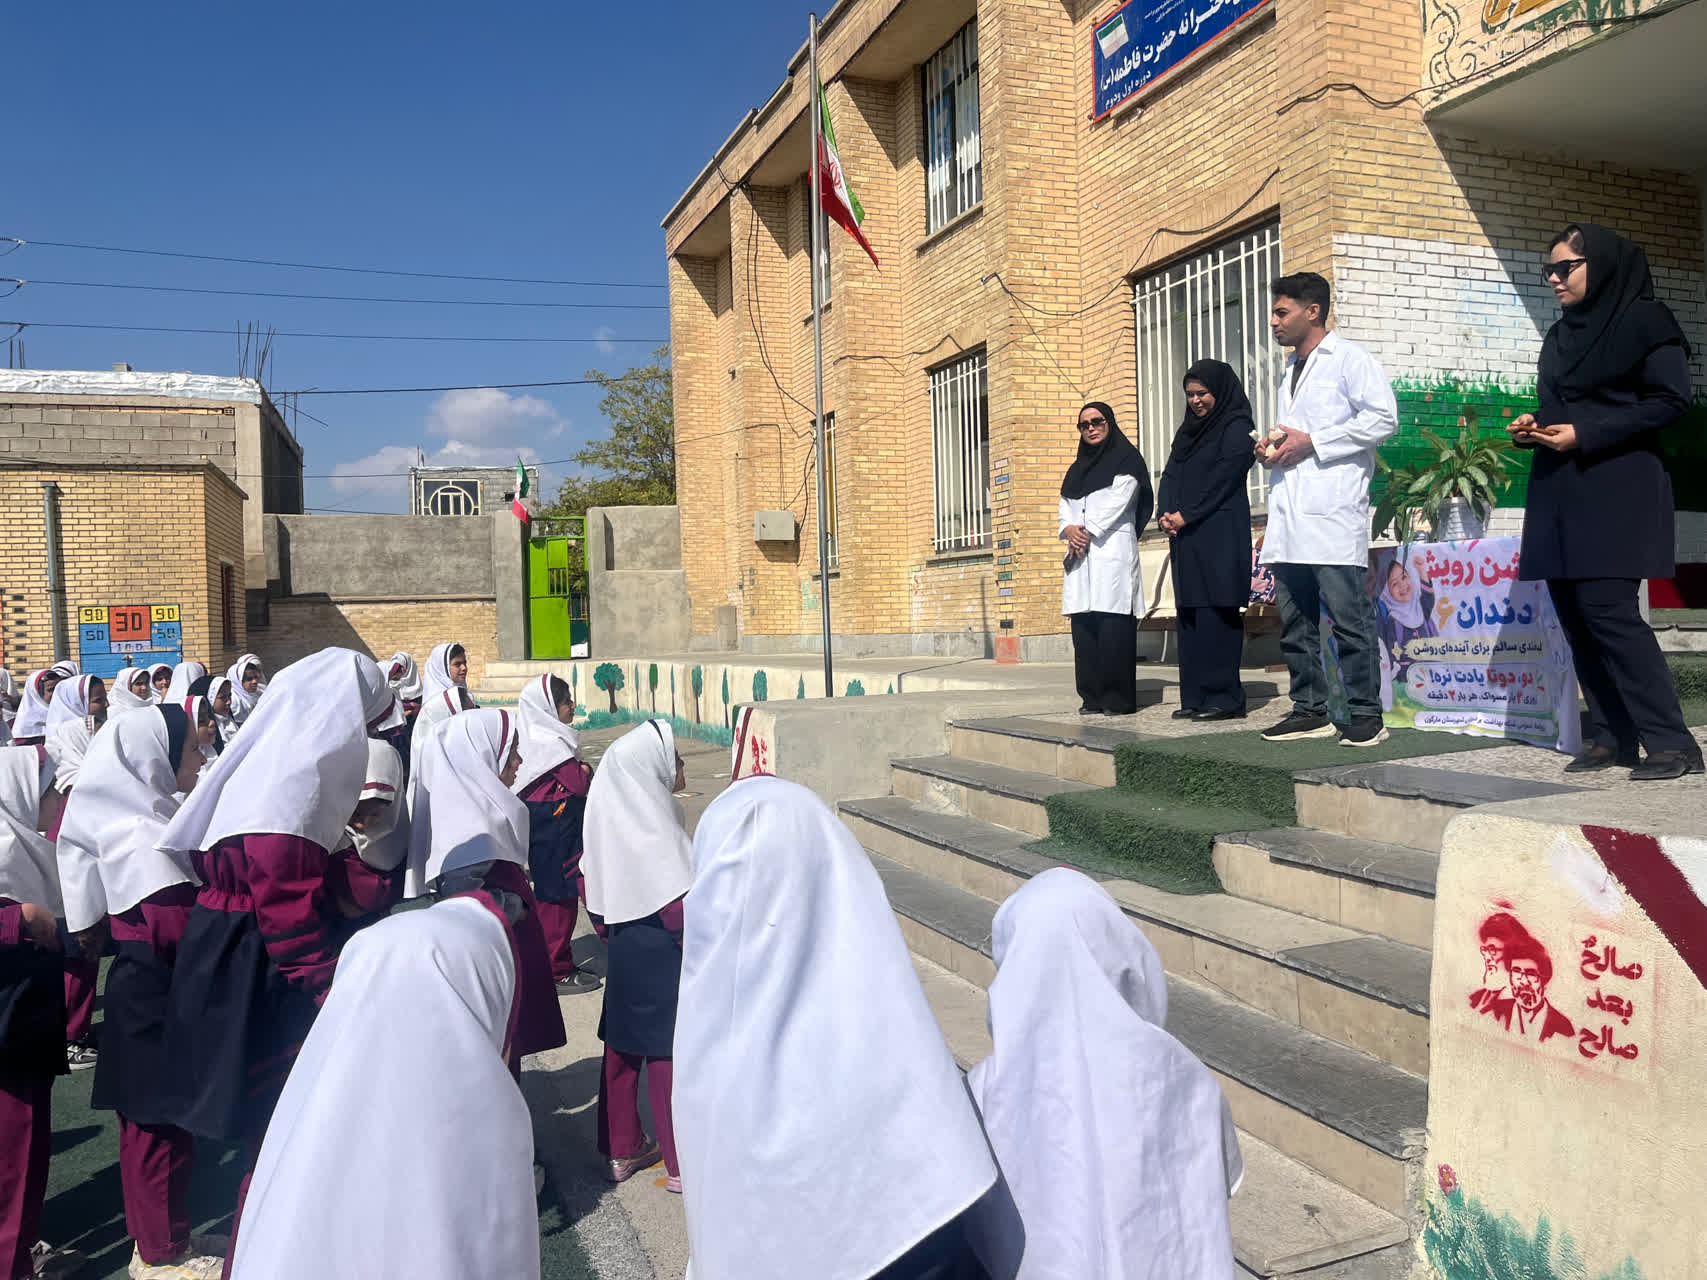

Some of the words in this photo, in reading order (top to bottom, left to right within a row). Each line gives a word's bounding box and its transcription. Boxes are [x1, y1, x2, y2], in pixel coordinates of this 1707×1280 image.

[1143, 31, 1176, 63] حضرت
[1122, 79, 1134, 98] اول
[1134, 70, 1152, 88] دوره
[115, 612, 142, 632] 30
[1457, 596, 1532, 629] دندان
[1413, 642, 1438, 656] روشن
[1472, 641, 1490, 656] برای
[1429, 668, 1452, 687] نره!
[1455, 668, 1484, 687] یادت
[1427, 690, 1449, 702] دقیقه
[1458, 691, 1466, 702] بار
[1469, 693, 1478, 702] هر
[1587, 987, 1633, 1026] بعد
[1579, 1025, 1638, 1060] صالح
